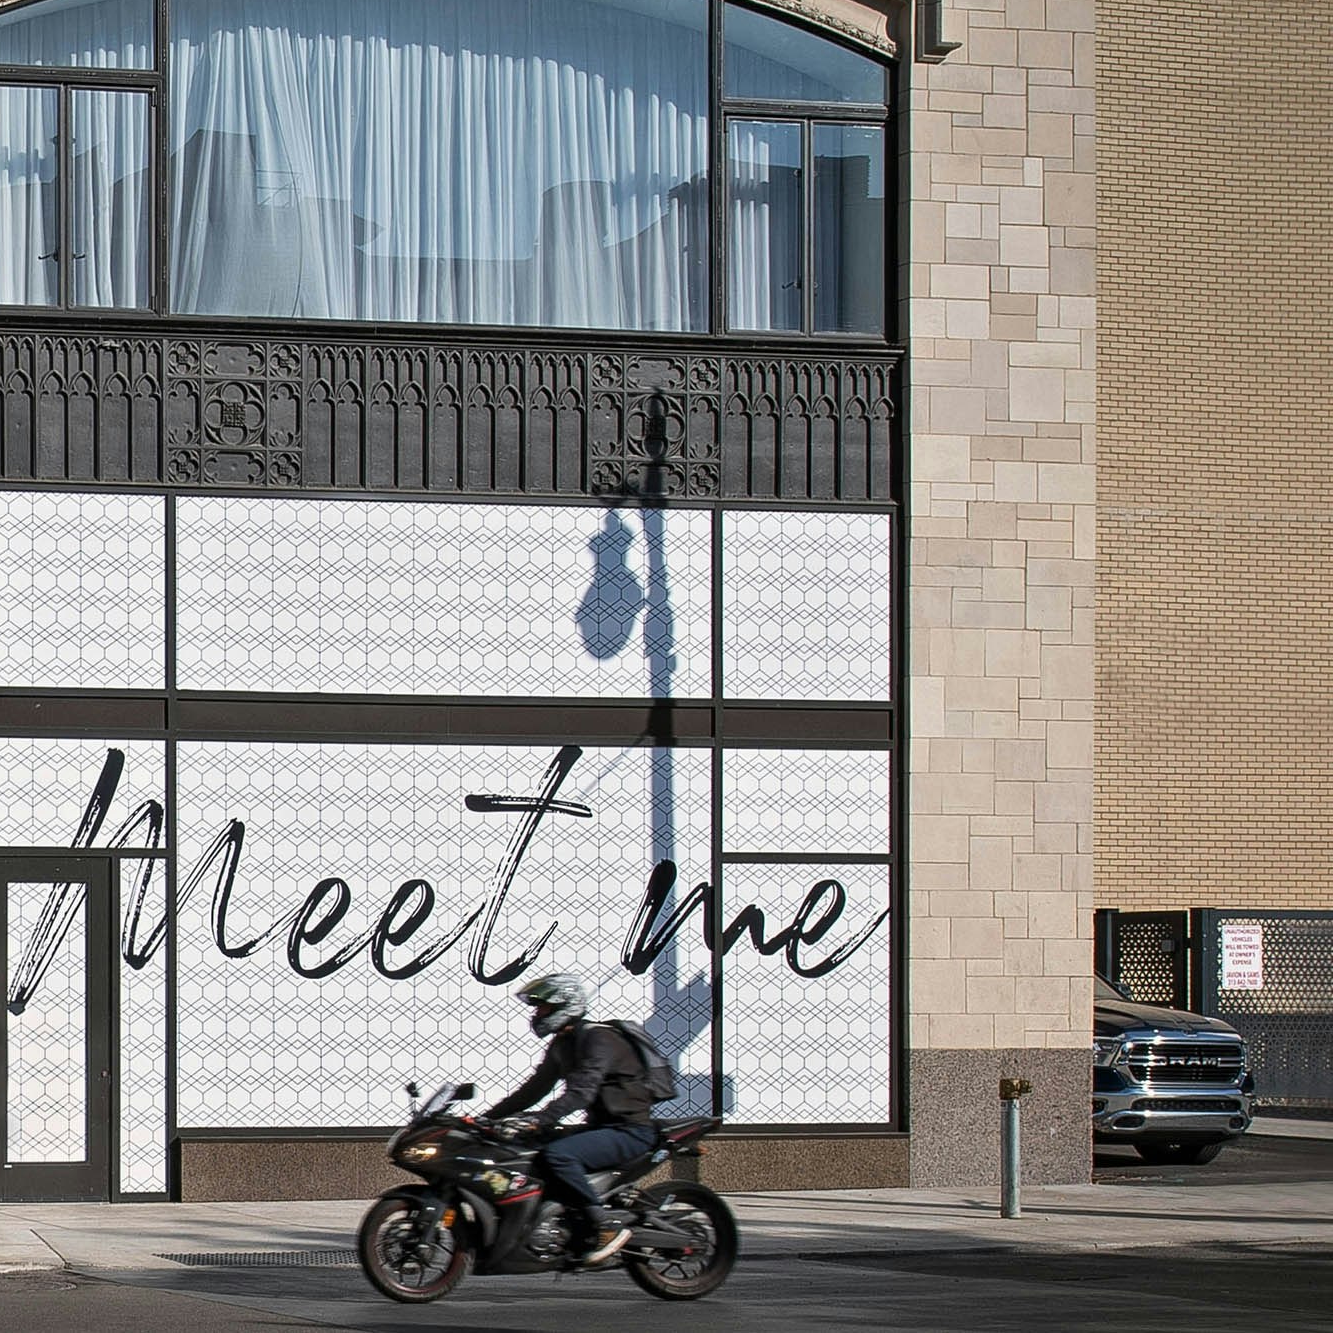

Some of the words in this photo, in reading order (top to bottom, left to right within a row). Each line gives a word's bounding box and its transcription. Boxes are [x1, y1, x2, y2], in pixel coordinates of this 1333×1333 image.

[6, 745, 593, 1015] Meet
[619, 859, 891, 979] me
[1169, 1056, 1217, 1066] RAM
